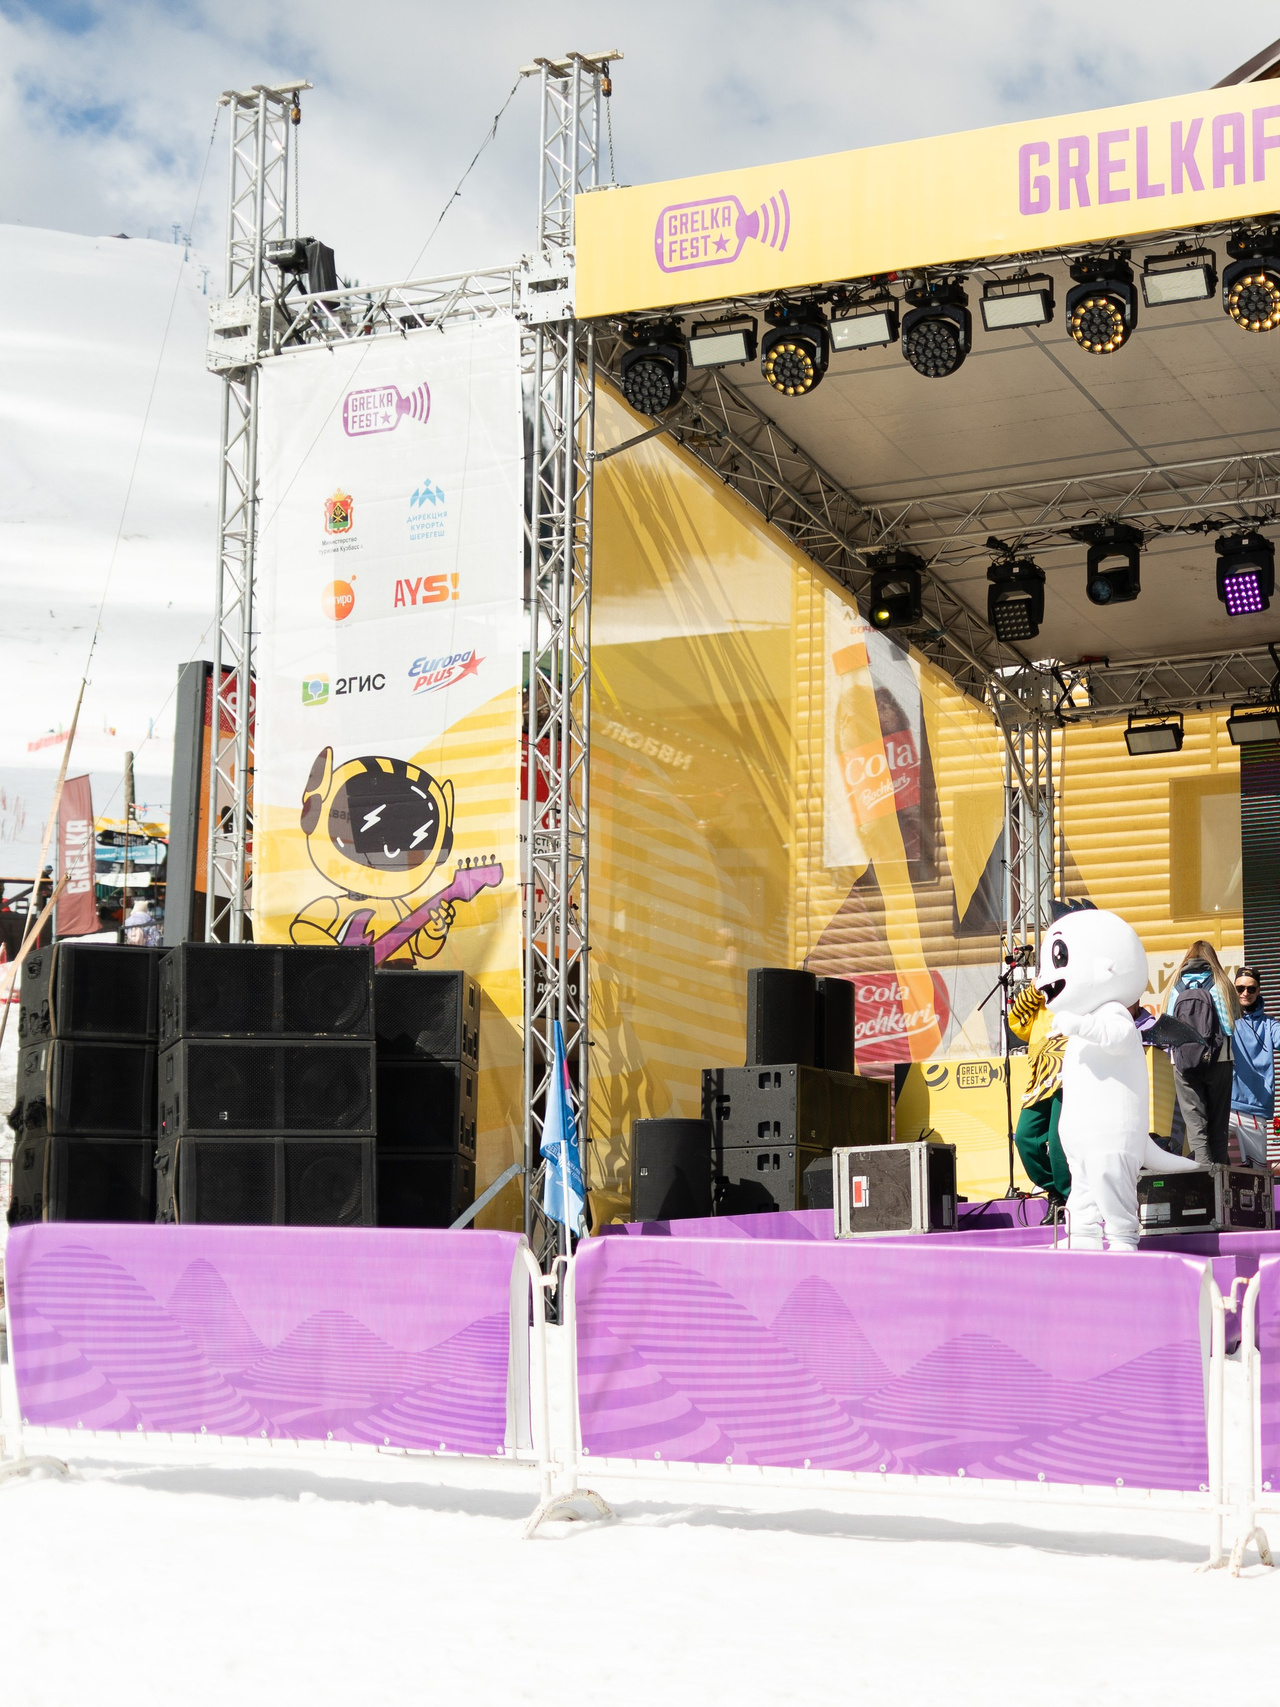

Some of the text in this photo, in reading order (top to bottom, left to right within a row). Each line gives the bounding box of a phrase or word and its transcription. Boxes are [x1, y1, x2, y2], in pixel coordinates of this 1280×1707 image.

[668, 205, 732, 237] GRELKA
[668, 234, 711, 262] FEST
[351, 392, 393, 413] GRELKA
[351, 411, 379, 430] FEST
[406, 510, 448, 524] ДИРЕКЦИЯ
[410, 521, 445, 532] КУРОРТА
[409, 530, 445, 541] ШЕРЕГЕШ
[394, 571, 460, 608] AYS!
[407, 650, 473, 678] Europa
[335, 673, 386, 696] 2ГИС
[844, 741, 916, 786] Cola
[860, 772, 911, 806] Bochkari
[857, 981, 910, 1004] Cola
[855, 1003, 940, 1040] ochkari
[961, 1065, 988, 1076] GRELKA
[961, 1075, 980, 1086] FEST
